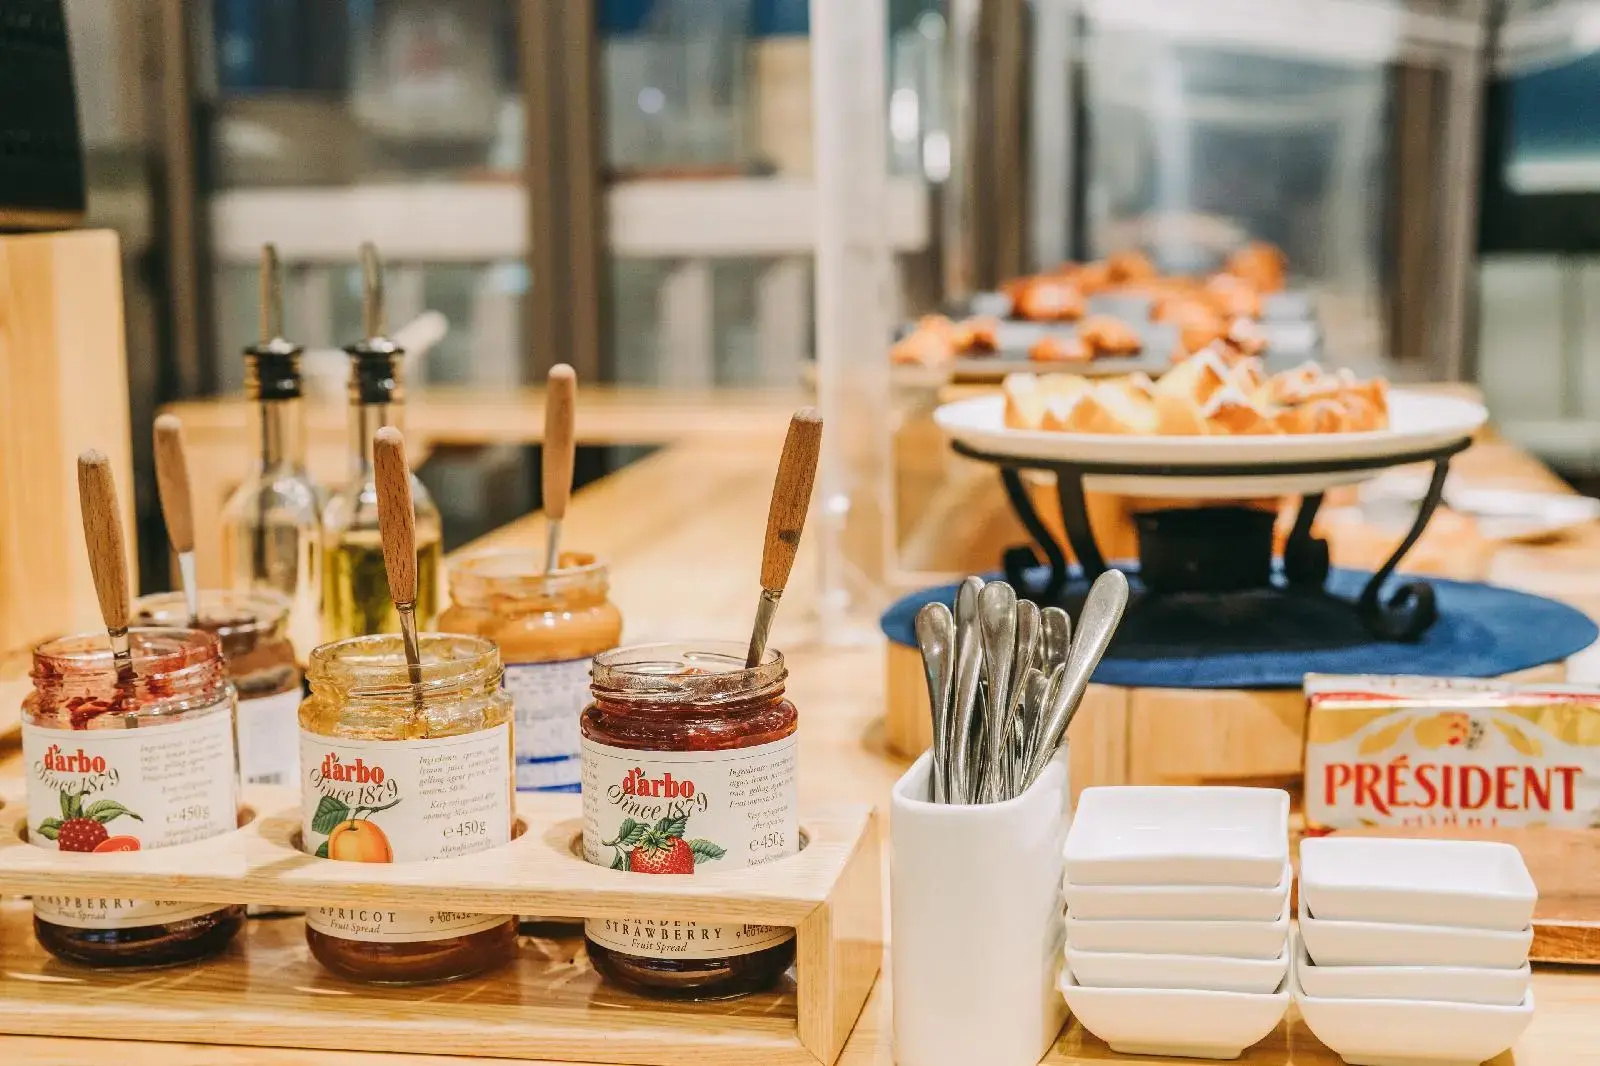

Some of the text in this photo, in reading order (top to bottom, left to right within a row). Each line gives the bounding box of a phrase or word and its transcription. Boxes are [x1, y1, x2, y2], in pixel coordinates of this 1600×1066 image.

[34, 761, 120, 796] Since 1879
[309, 768, 398, 805] Since 1879
[1325, 754, 1584, 817] PRÉSIDENT
[606, 784, 708, 820] Since 1879
[319, 906, 396, 923] APRICOT
[330, 919, 381, 935] Fruit Spread
[605, 919, 722, 941] STRAWBERRY
[631, 938, 688, 954] Fruit Spread
